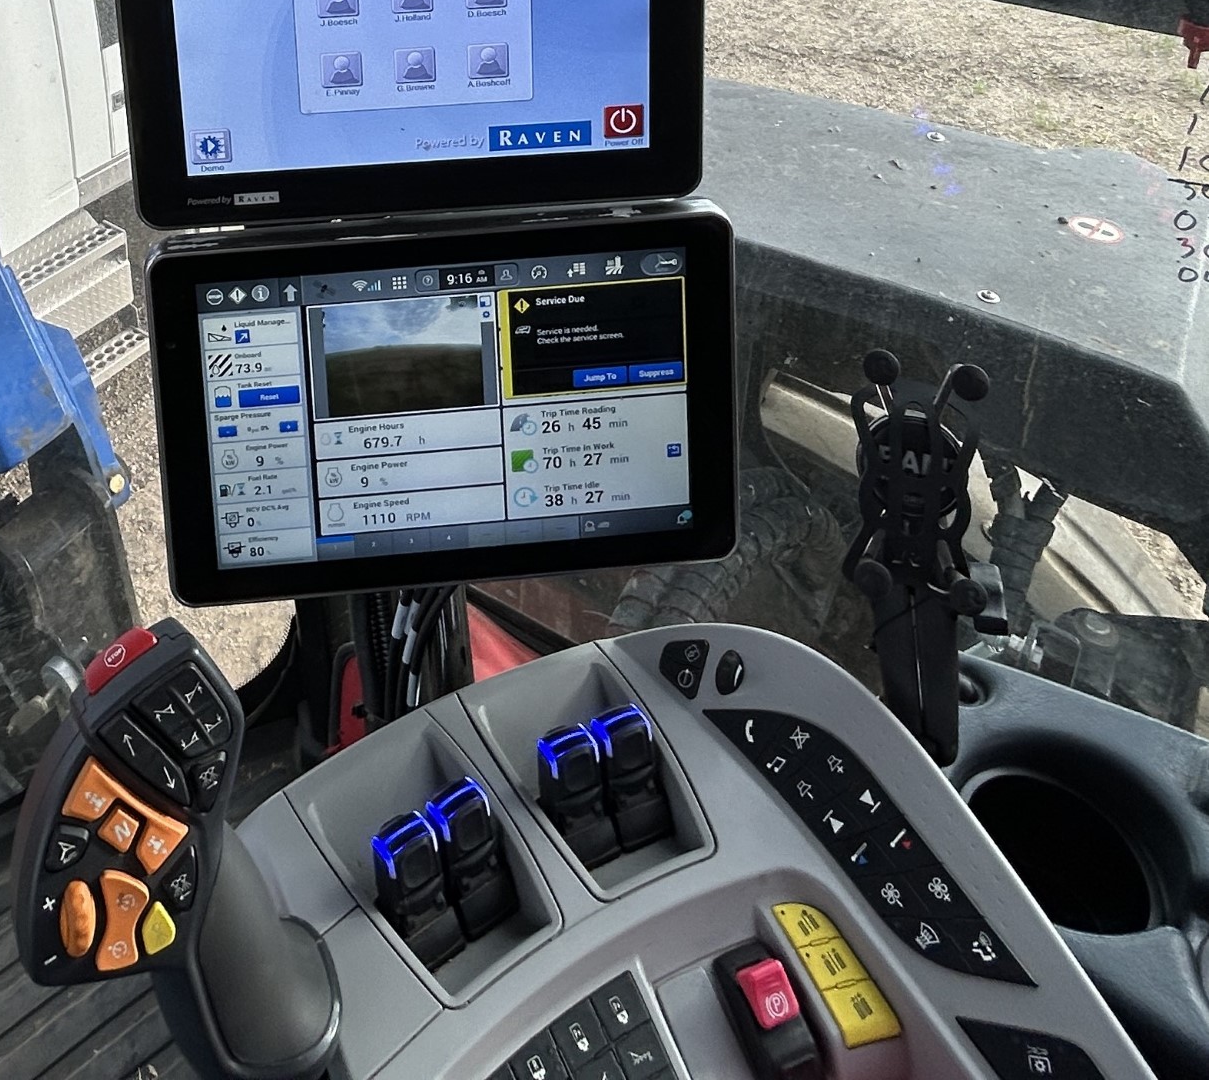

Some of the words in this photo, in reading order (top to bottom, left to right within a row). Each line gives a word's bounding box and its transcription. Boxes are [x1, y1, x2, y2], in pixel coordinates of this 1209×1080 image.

[416, 135, 466, 149] Powered
[470, 134, 484, 148] by
[500, 130, 580, 146] RAVEN
[187, 196, 220, 206] Powered
[222, 196, 232, 204] by
[238, 195, 274, 203] RAVEN
[446, 273, 472, 286] 9:16
[535, 296, 566, 306] Service
[568, 295, 585, 304] Due
[536, 327, 562, 336] Service
[536, 336, 558, 345] Check
[572, 334, 598, 342] service
[235, 362, 262, 373] 73.9
[638, 368, 674, 378] Suppress
[584, 374, 606, 383] Jump
[541, 410, 556, 418] Trip
[582, 406, 616, 414] Roading
[348, 425, 377, 434] Engine
[379, 422, 404, 430] Hours
[542, 420, 560, 434] 26
[568, 423, 574, 431] h
[582, 417, 601, 430] 45
[609, 418, 628, 428] min
[364, 436, 402, 449] 679.7
[418, 436, 426, 445] h
[593, 442, 614, 450] Work
[256, 456, 264, 466] 9
[542, 456, 562, 469] 70
[570, 458, 576, 467] h
[584, 452, 602, 466] 27
[610, 455, 629, 464] min
[350, 463, 379, 472] Engine
[381, 461, 408, 469] Power
[360, 476, 368, 487] 9
[584, 481, 600, 489] Idle
[254, 485, 272, 495] 2.1
[353, 502, 382, 510] Engine
[384, 498, 410, 506] Speed
[544, 494, 564, 507] 38
[572, 496, 578, 504] h
[585, 490, 604, 504] 27
[611, 493, 630, 502] min
[248, 518, 254, 527] 0
[362, 512, 396, 526] 1110
[406, 512, 431, 522] RPM
[250, 546, 264, 556] 80
[107, 647, 122, 662] STOP
[114, 821, 132, 842] N
